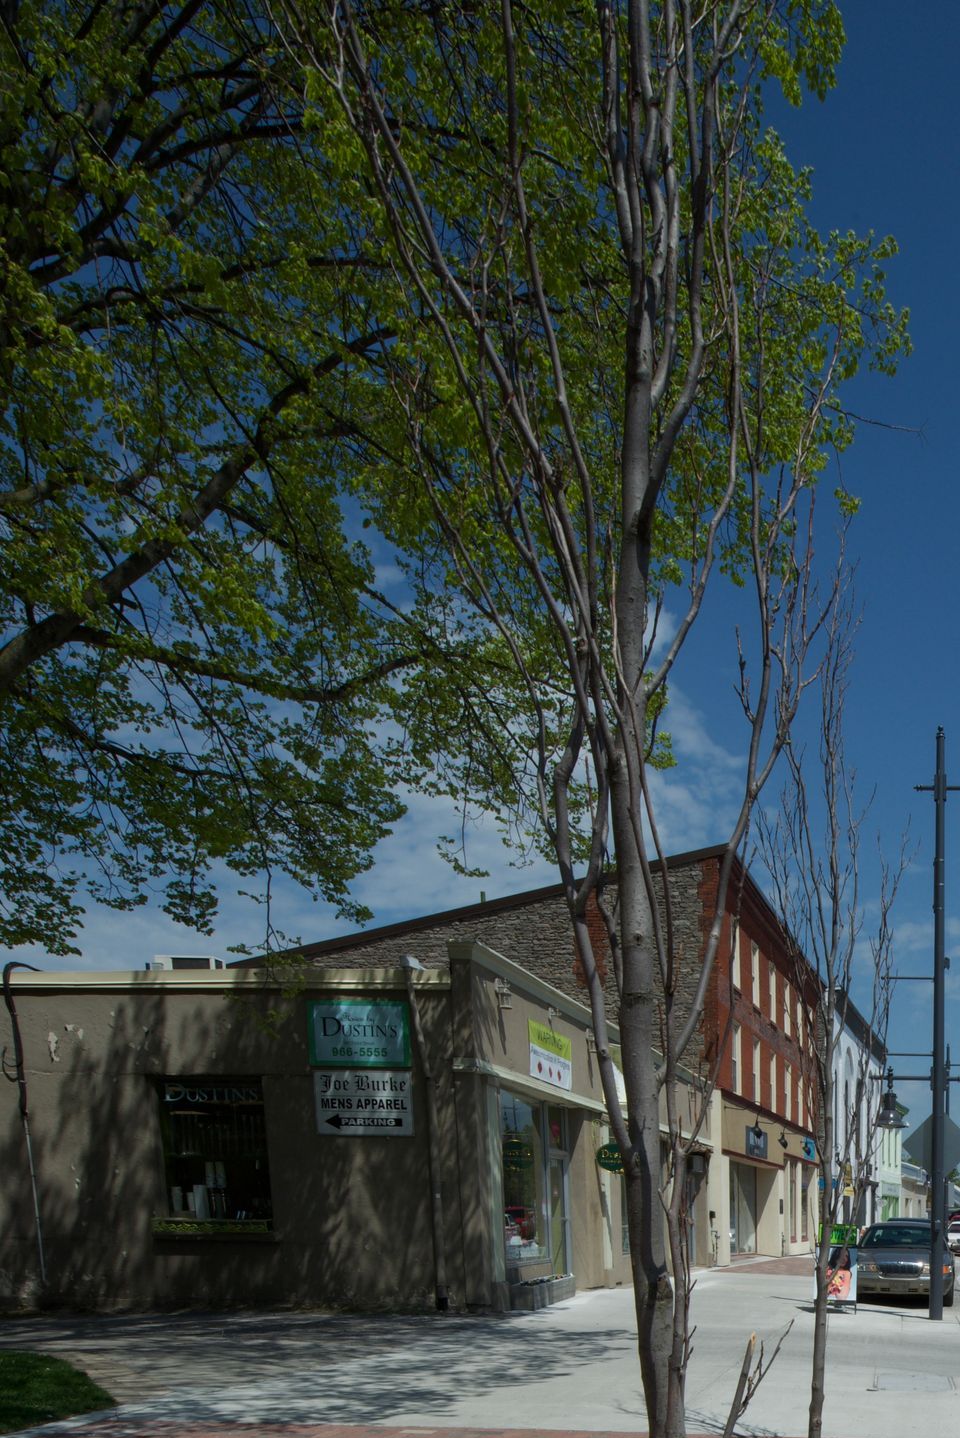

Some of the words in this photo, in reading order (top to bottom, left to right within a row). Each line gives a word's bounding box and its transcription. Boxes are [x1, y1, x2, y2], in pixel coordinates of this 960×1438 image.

[332, 1047, 388, 1057] 966-5555
[320, 1075, 350, 1093] Joe
[354, 1075, 407, 1091] Burke
[321, 1098, 353, 1110] MENS
[357, 1099, 407, 1110] APPAREL
[342, 1118, 397, 1127] PARKING
